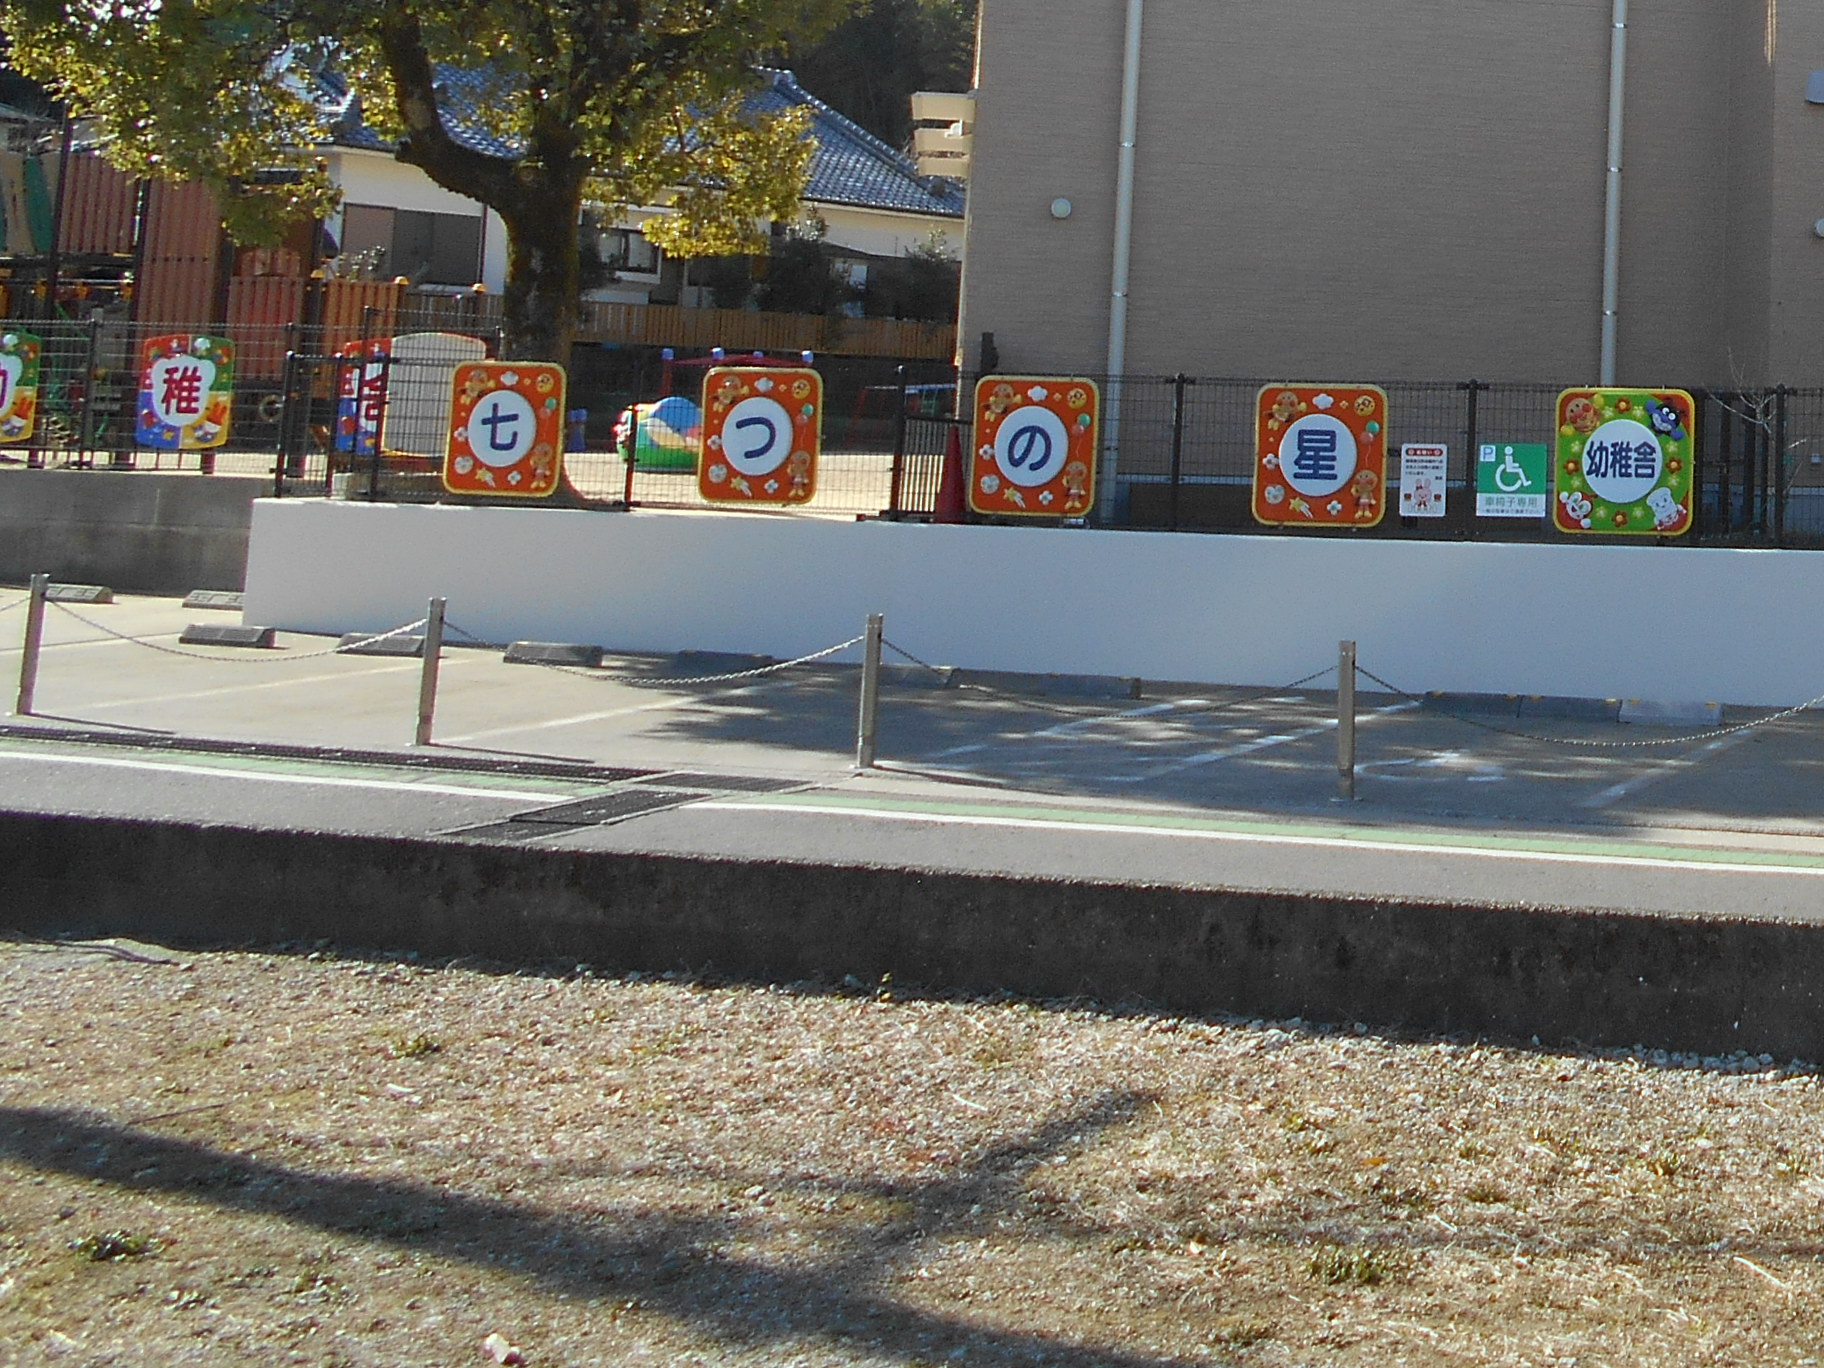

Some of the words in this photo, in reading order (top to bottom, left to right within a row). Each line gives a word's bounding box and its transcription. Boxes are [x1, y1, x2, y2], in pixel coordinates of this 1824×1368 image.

[162, 366, 202, 415] 稚
[481, 401, 518, 451] 七
[735, 415, 777, 460] つ
[1007, 425, 1052, 471] の
[1293, 429, 1338, 481] 星
[1586, 441, 1656, 479] 幼稚舎
[1483, 447, 1494, 460] P
